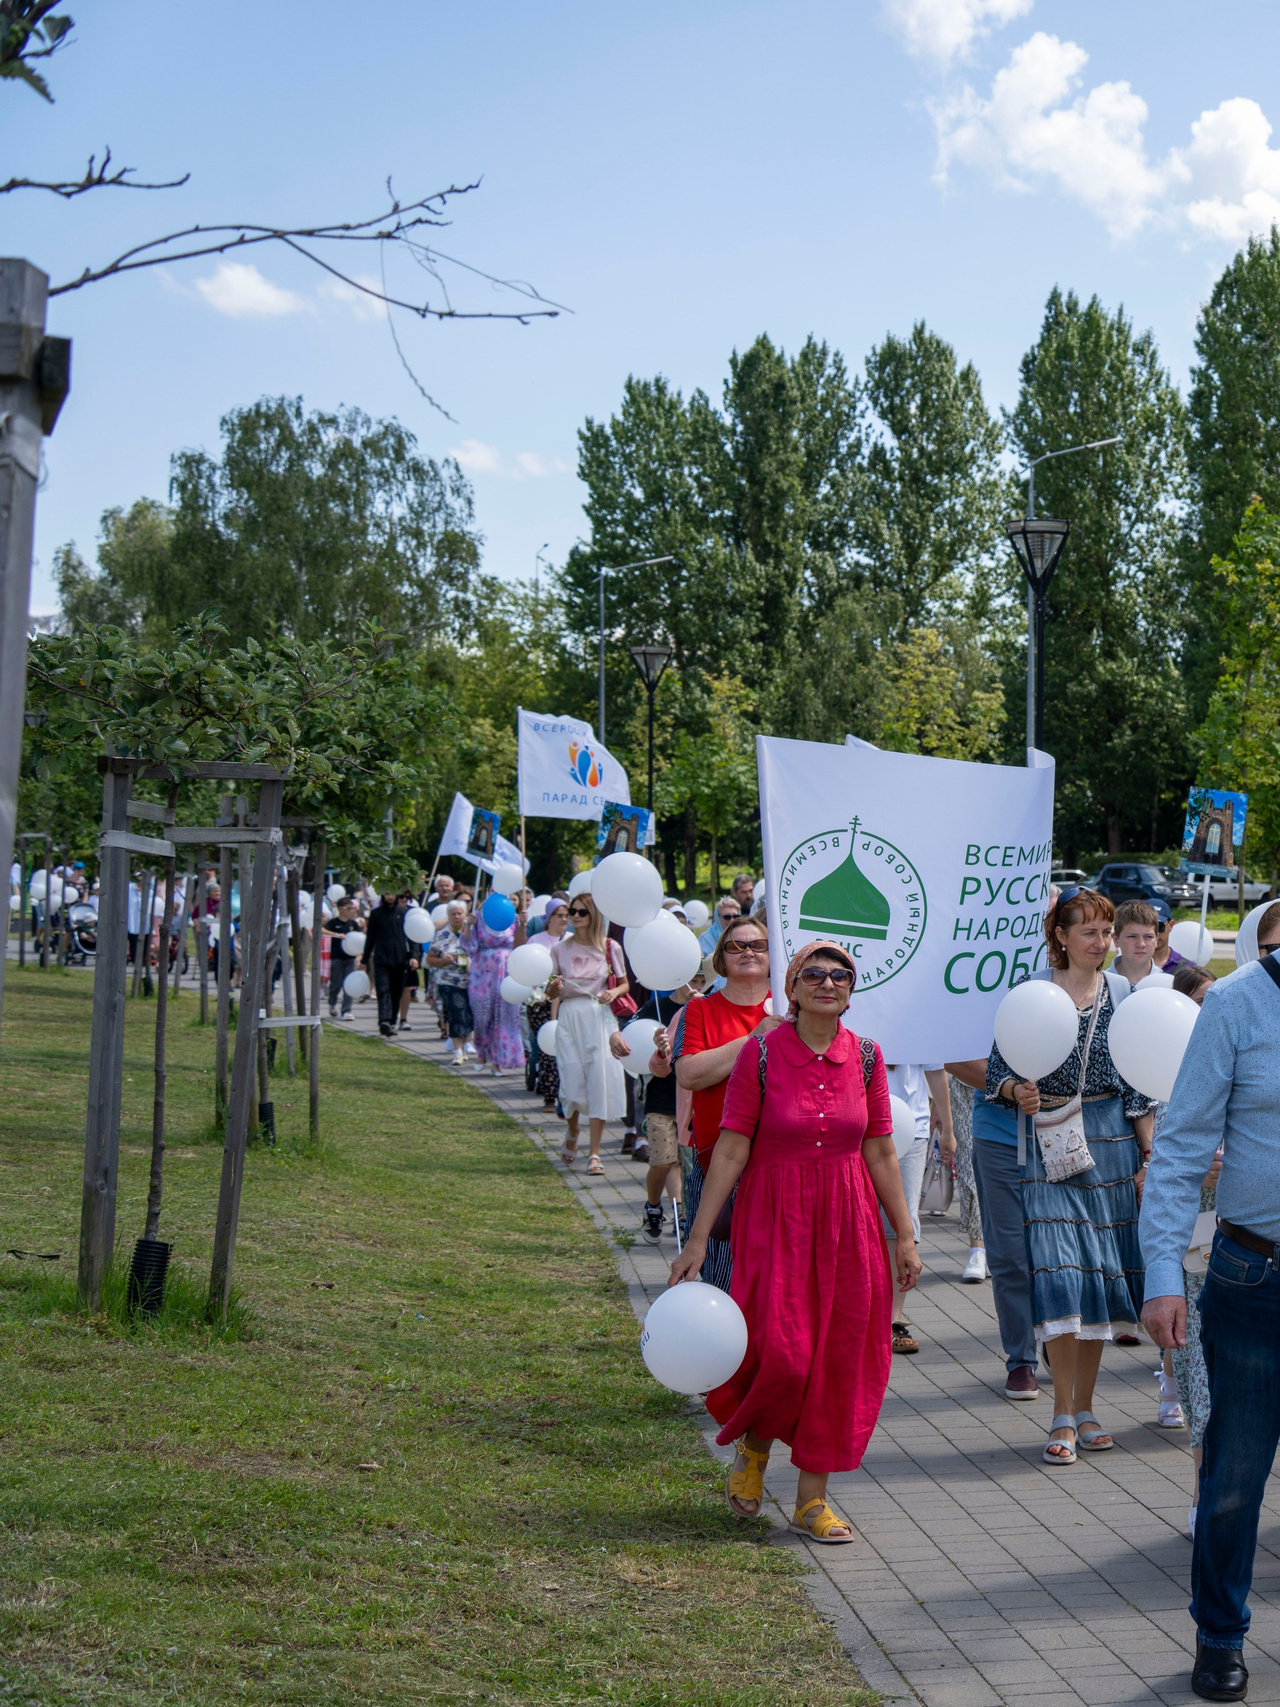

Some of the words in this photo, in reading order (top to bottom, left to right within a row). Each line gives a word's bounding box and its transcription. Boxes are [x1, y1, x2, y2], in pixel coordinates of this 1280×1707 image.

[542, 791, 588, 806] ПАРАД
[781, 836, 840, 930] ВСЕМИРНЫЙ
[861, 840, 912, 885] СОБОР
[959, 869, 1050, 906] РУССК
[861, 892, 920, 984] НАРОДНЫЙ
